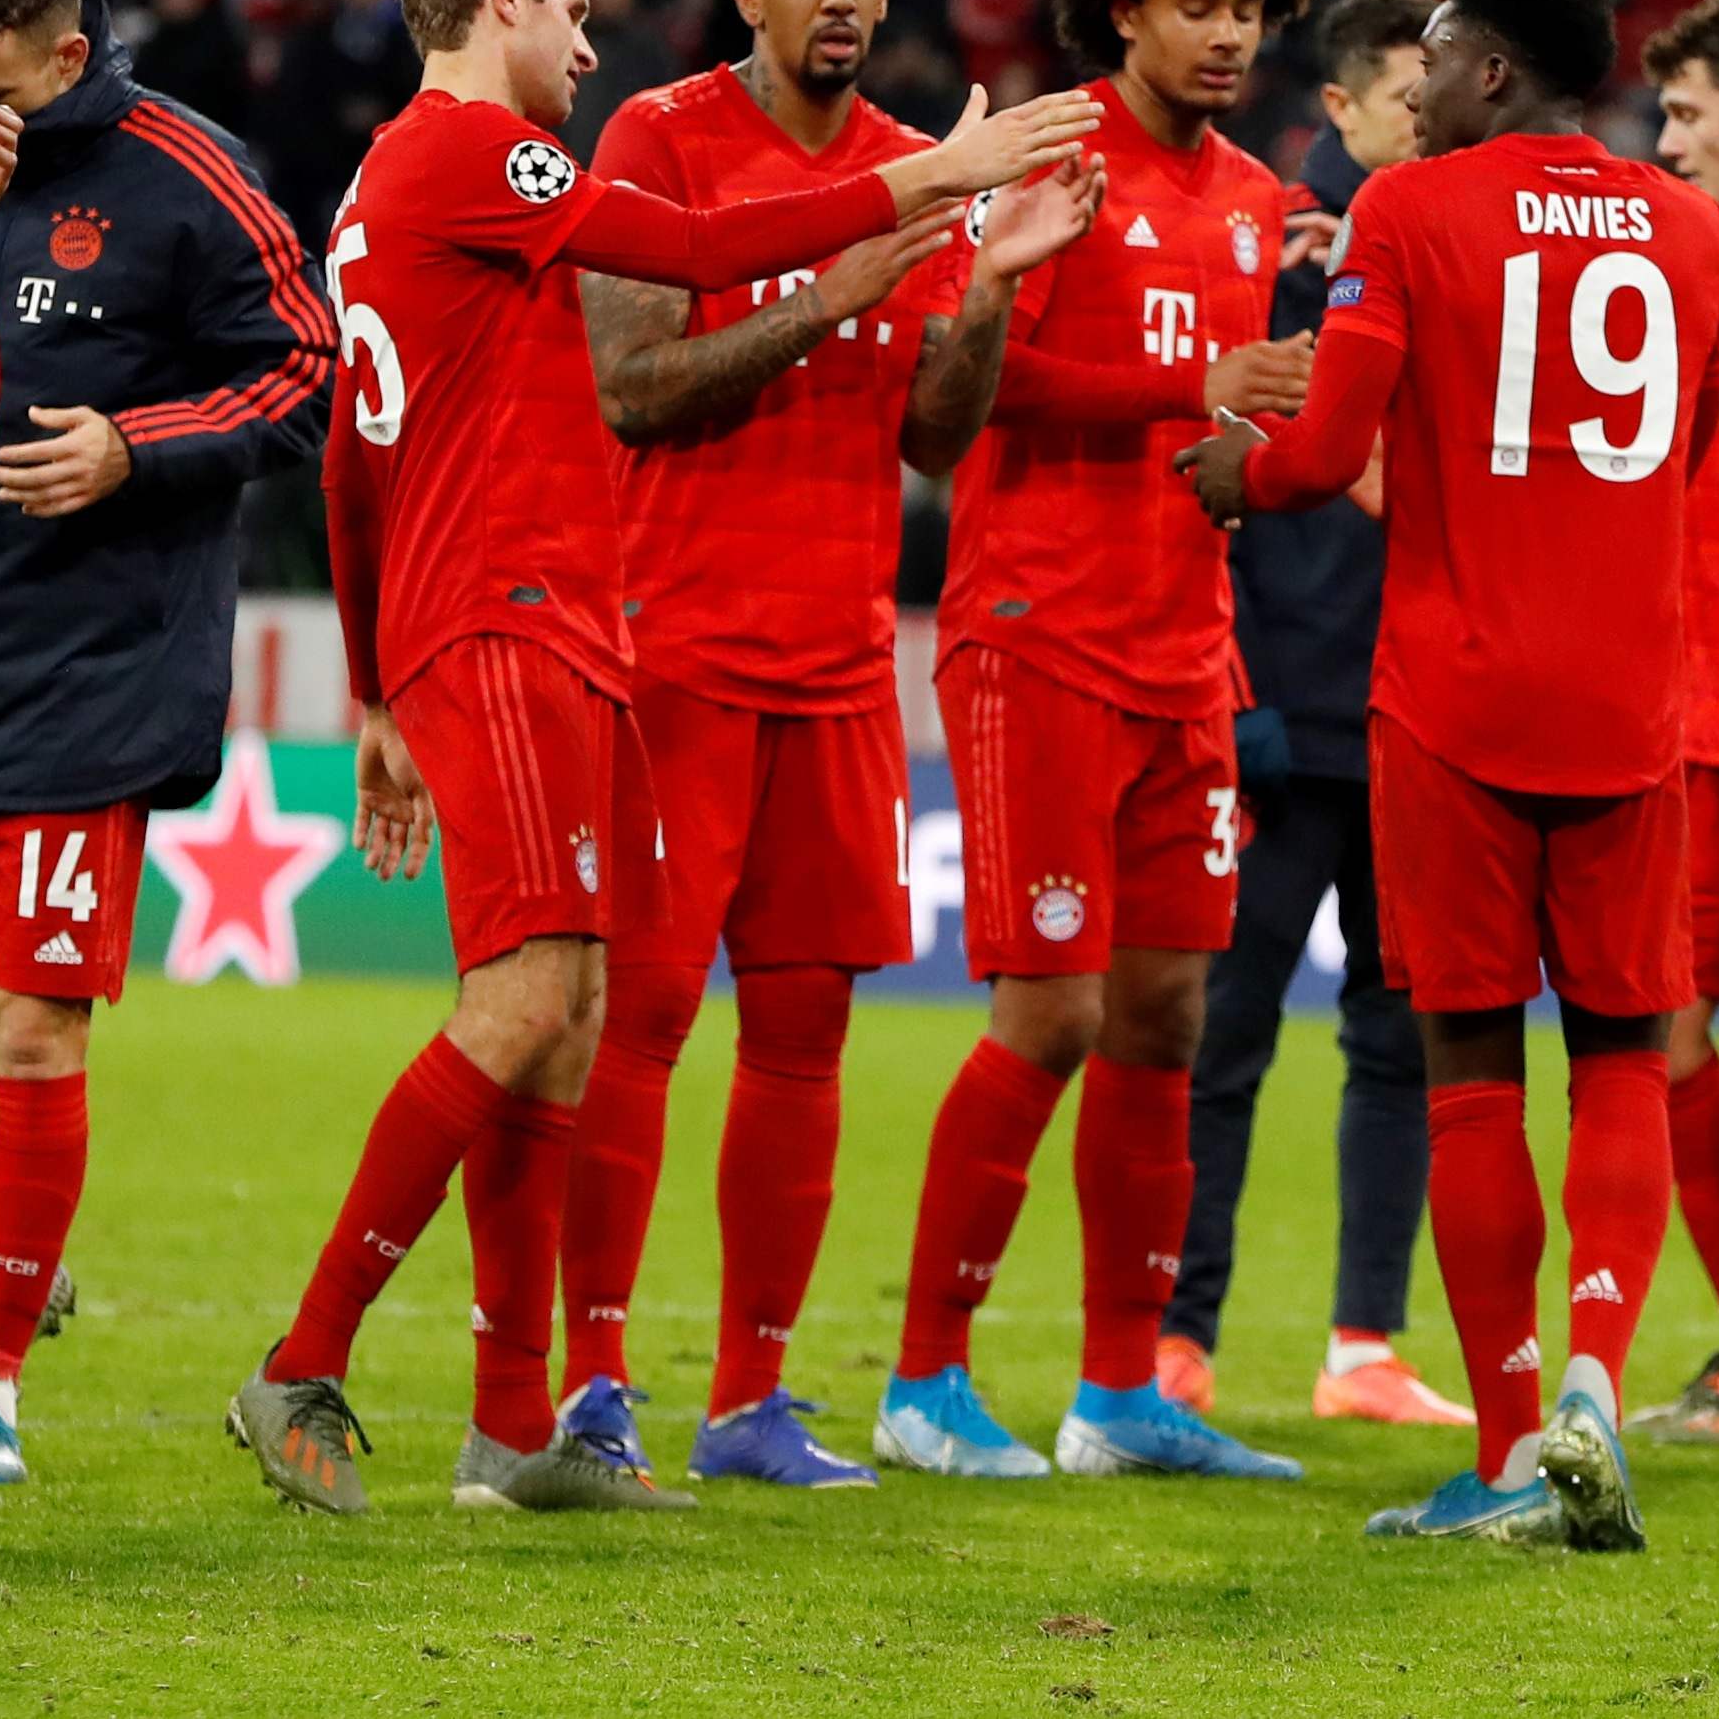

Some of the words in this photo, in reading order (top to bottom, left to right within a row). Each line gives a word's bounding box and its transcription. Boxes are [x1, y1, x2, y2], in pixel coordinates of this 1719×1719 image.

[1515, 190, 1654, 242] DAVIES
[325, 221, 405, 447] 5
[1490, 250, 1679, 483] 19
[18, 828, 98, 922] 14
[1203, 788, 1238, 878] 3
